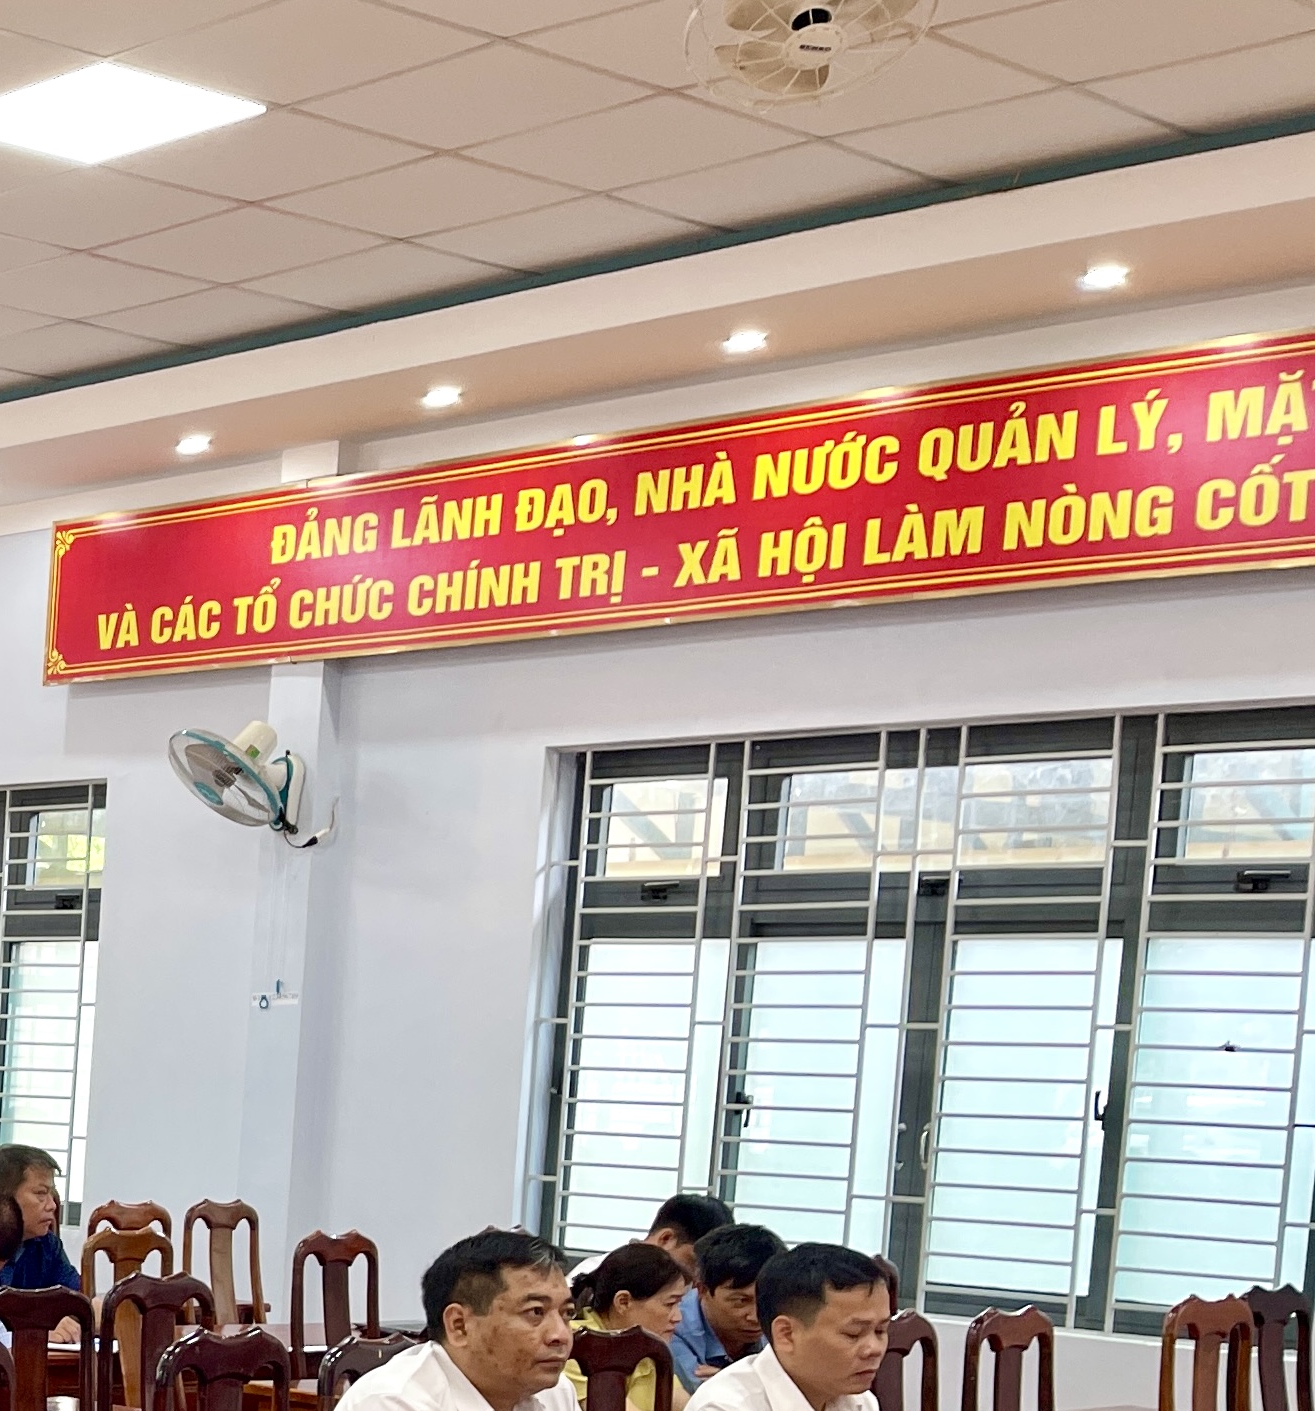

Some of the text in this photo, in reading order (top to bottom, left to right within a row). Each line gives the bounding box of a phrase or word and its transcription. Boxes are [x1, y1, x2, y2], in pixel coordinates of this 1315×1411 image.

[98, 455, 1315, 649] VÀ CÁC TỔ CHỨC CHÍNH TRỊ - XÃ HỘI LÀM NÒNG CỐT
[270, 370, 1315, 564] ĐẢNG LÃNH ĐẠO, NHÀ NƯỚC QUẢN LÝ, MẶ
